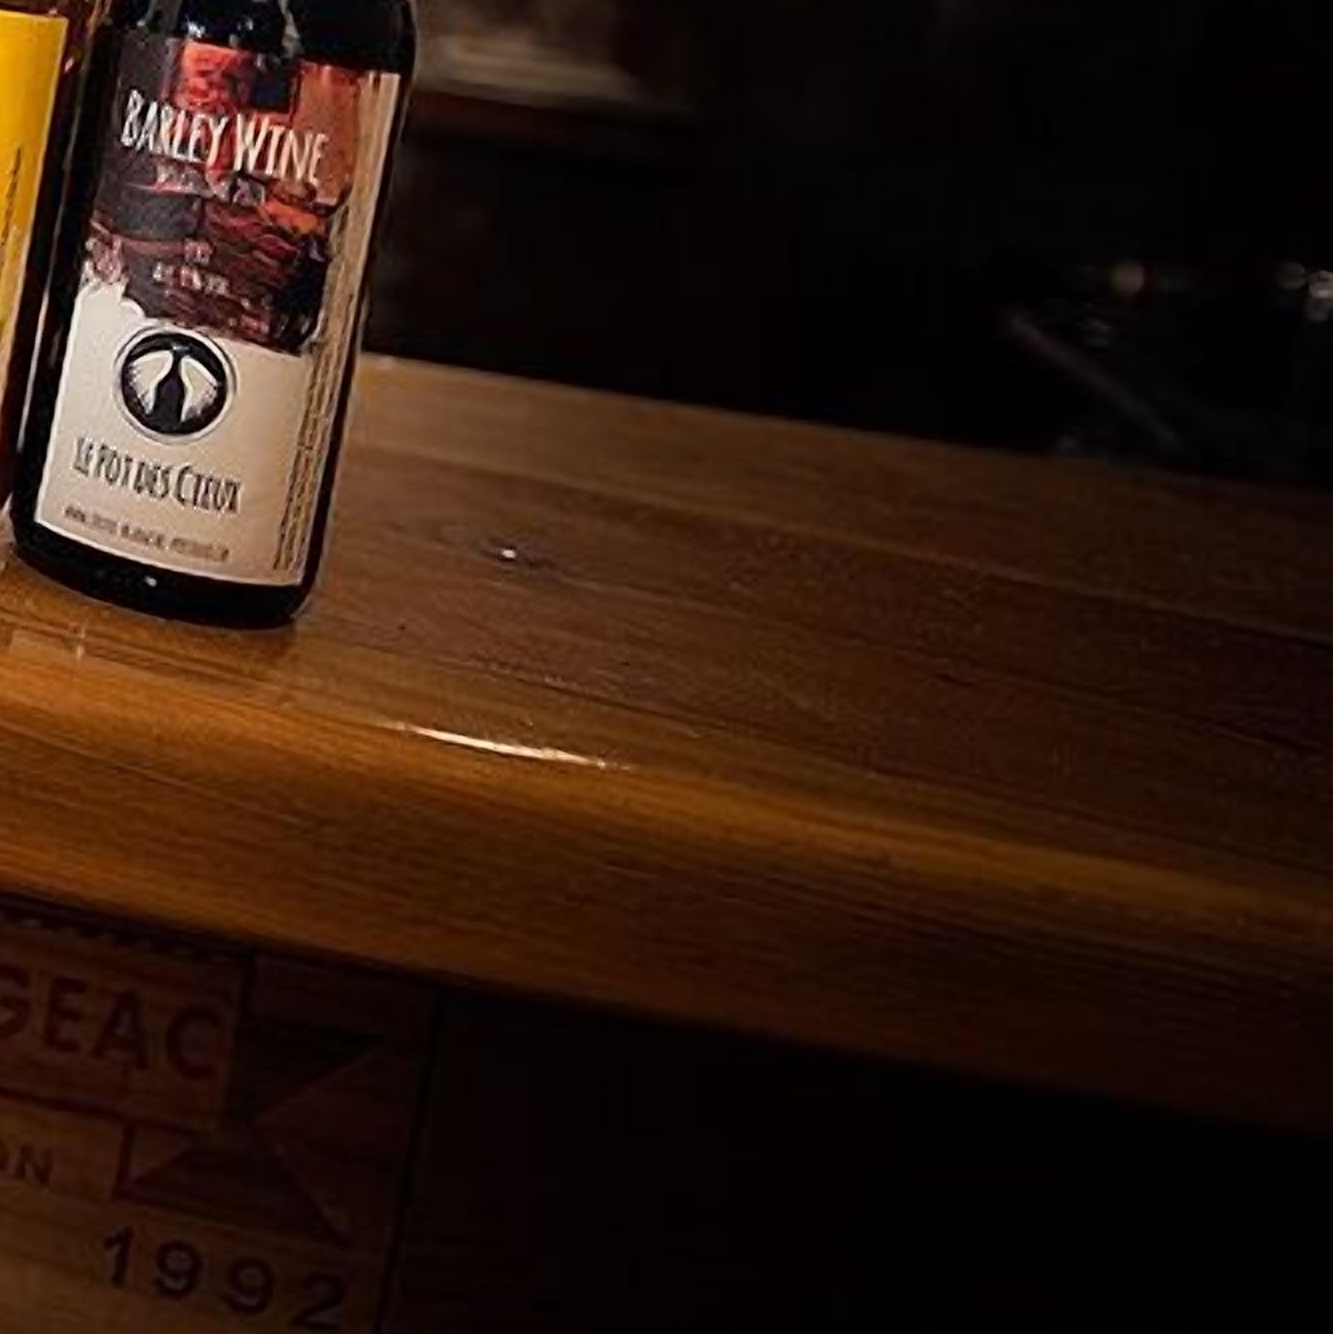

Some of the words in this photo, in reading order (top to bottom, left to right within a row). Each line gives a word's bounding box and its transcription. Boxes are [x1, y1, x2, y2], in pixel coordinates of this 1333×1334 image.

[119, 88, 230, 169] BARLEY
[231, 113, 330, 188] WINE
[103, 1224, 347, 1333] 1992
